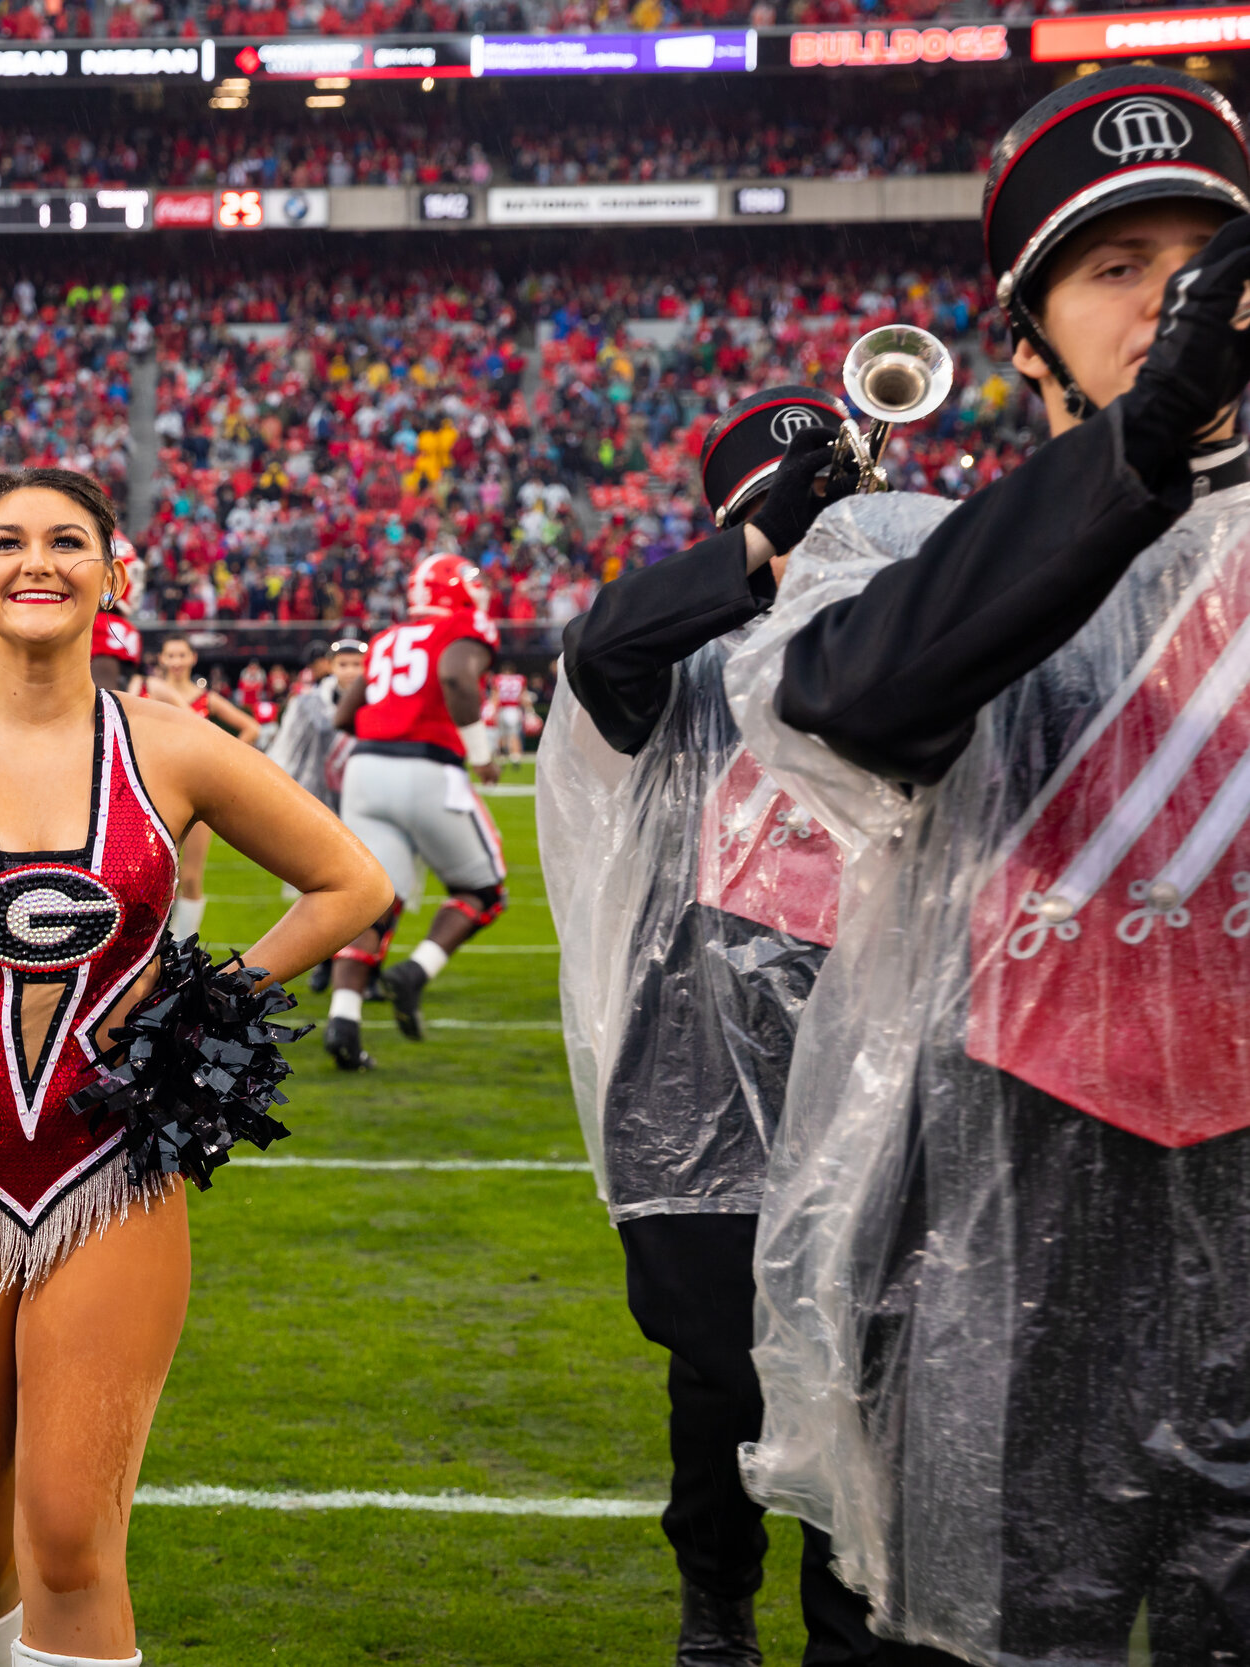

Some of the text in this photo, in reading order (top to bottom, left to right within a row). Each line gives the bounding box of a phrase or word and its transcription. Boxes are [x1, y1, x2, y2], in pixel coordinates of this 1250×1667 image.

[81, 49, 198, 76] NISSAN
[790, 25, 1008, 67] BULLDOGS
[219, 191, 262, 227] 25
[365, 624, 435, 705] 55
[6, 888, 117, 945] G
